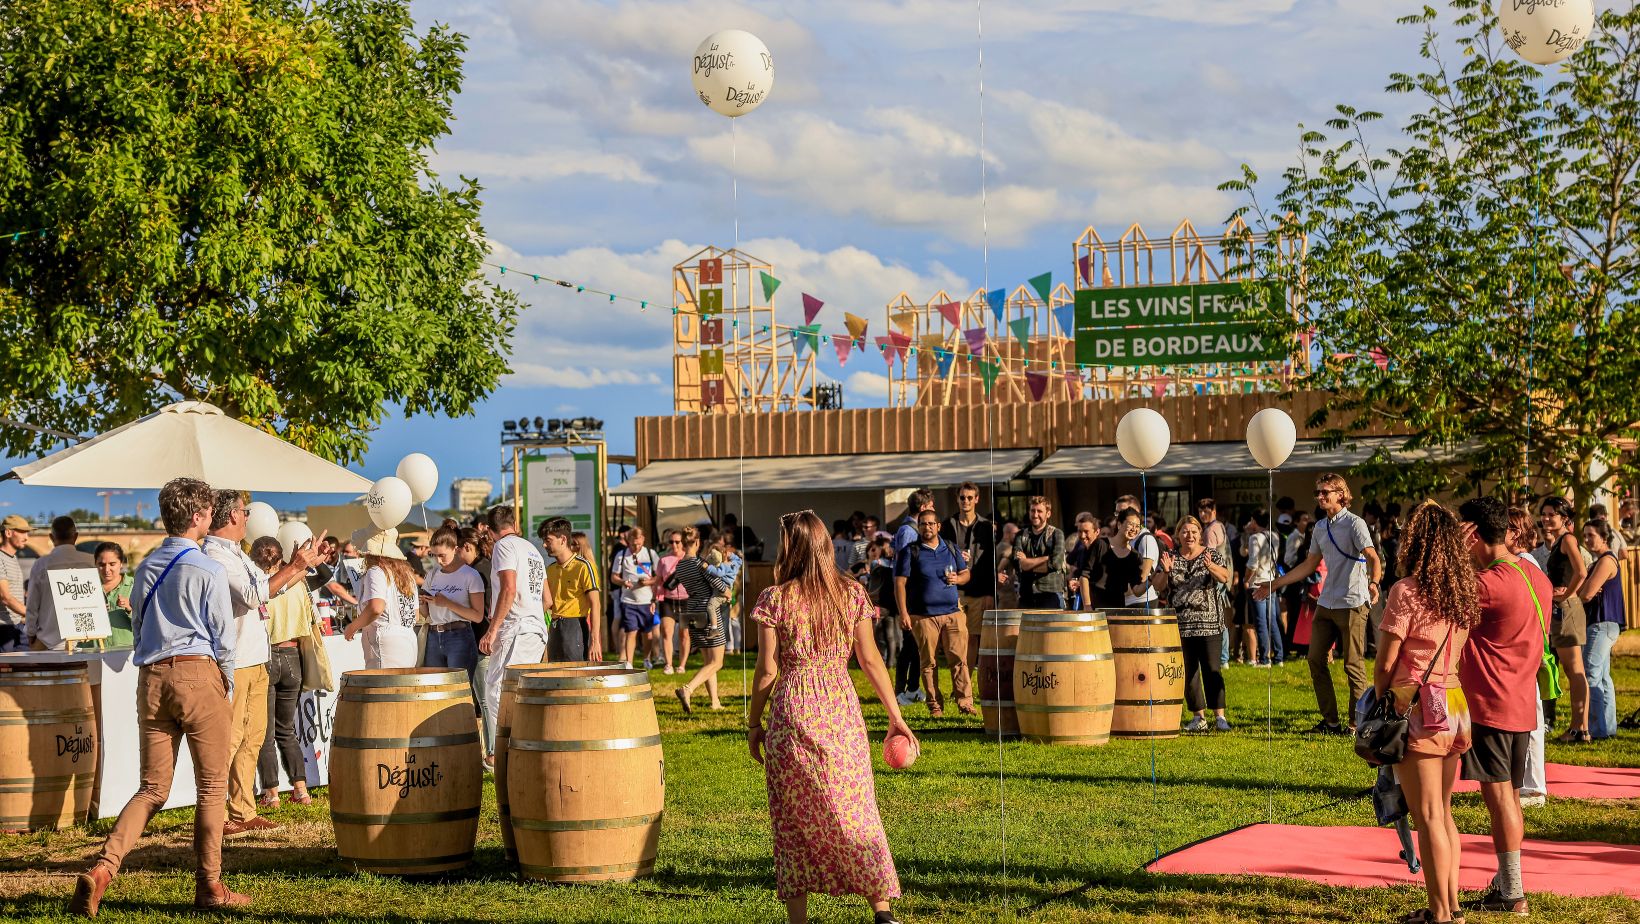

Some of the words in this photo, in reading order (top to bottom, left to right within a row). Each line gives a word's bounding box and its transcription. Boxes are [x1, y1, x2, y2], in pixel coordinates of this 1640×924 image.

[711, 43, 719, 51] La
[747, 81, 755, 90] La
[1091, 299, 1130, 319] LES
[1136, 296, 1192, 317] VINS
[1095, 339, 1125, 358] DE
[1132, 334, 1265, 357] BORDEAUX
[70, 574, 78, 582] La
[1035, 664, 1042, 673] La
[74, 724, 83, 735] La
[405, 752, 416, 764] La
